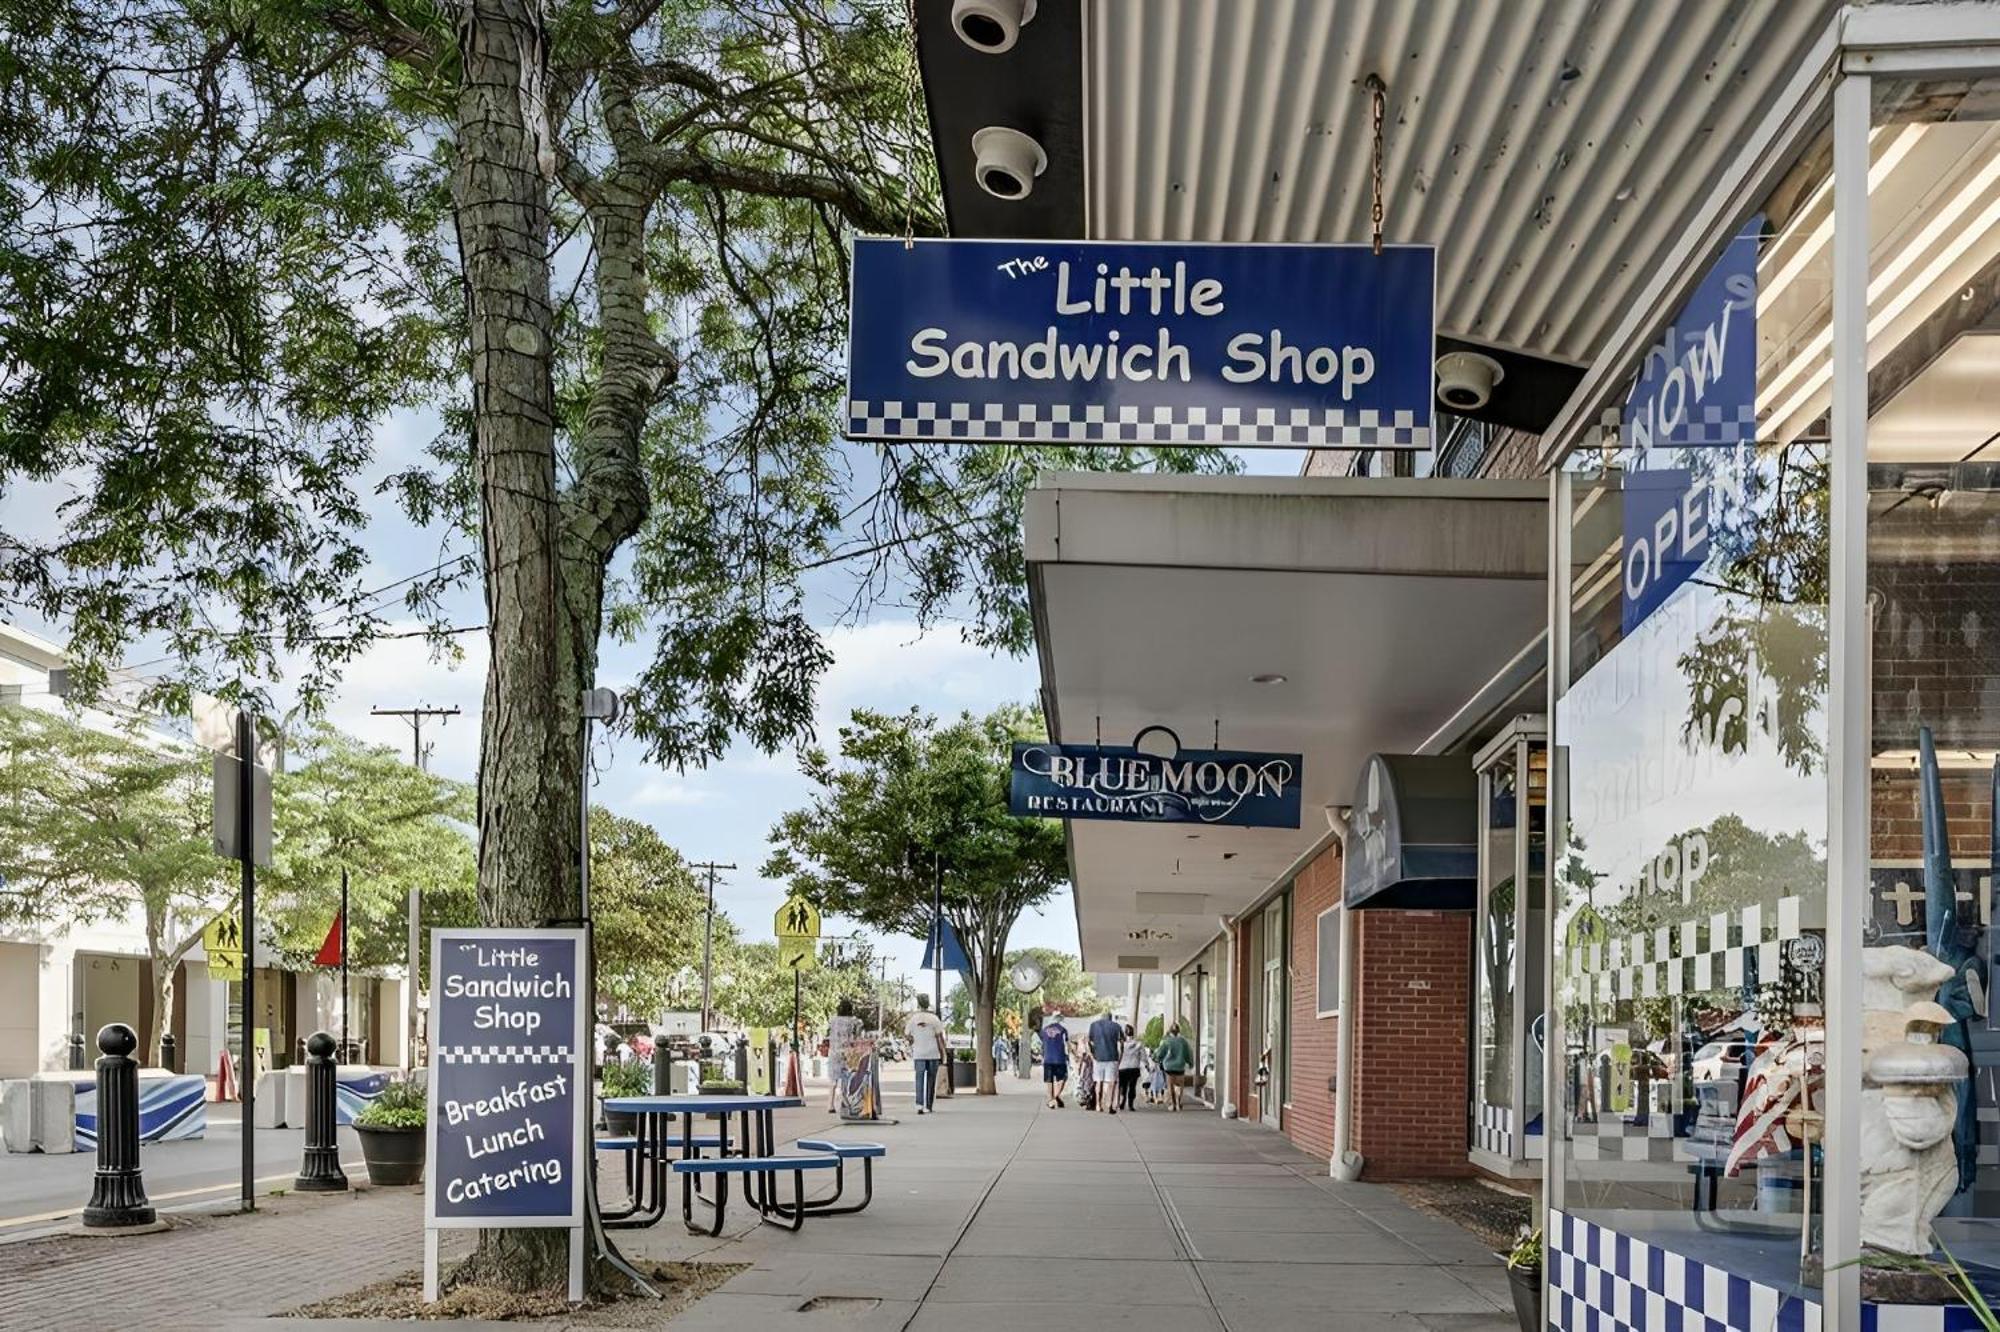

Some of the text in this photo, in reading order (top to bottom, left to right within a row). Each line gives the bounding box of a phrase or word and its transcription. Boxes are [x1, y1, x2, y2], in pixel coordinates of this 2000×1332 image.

[996, 255, 1049, 279] The
[1056, 261, 1224, 315] Little
[906, 326, 1376, 400] Sandwich Shop
[1631, 299, 1734, 474] NOW
[1626, 439, 1746, 601] OPEN
[1040, 753, 1292, 804] BLUE MOON
[1027, 795, 1167, 816] RESTAURANT
[478, 946, 539, 968] Little
[444, 972, 571, 1000] Sandwich
[473, 1003, 541, 1036] Shop
[444, 1073, 567, 1126] Breakfast
[465, 1117, 545, 1160] Lunch
[446, 1158, 562, 1204] Catering
